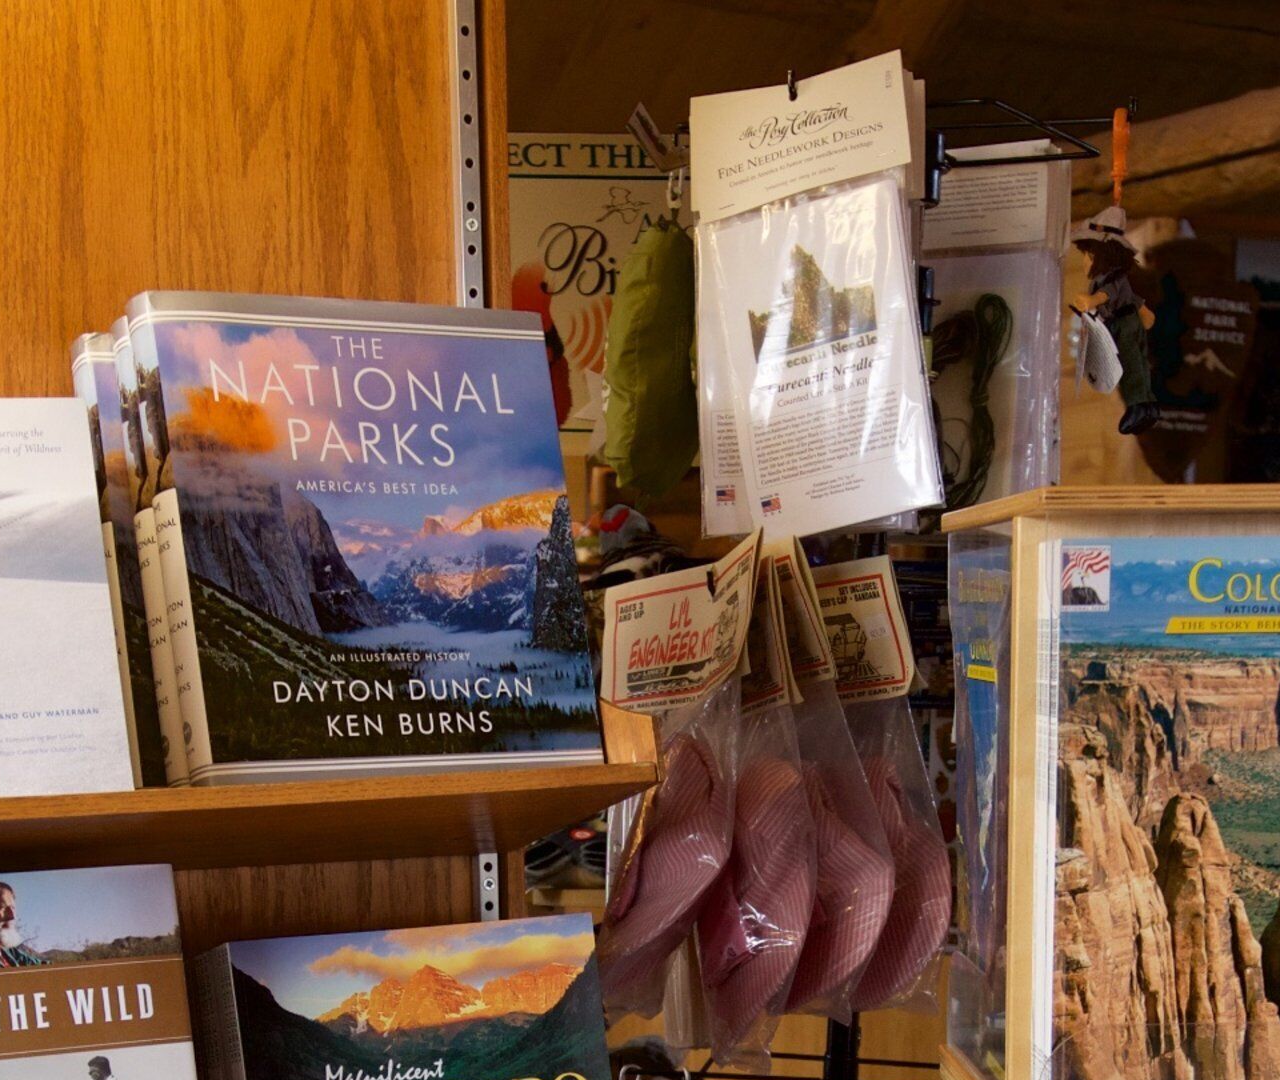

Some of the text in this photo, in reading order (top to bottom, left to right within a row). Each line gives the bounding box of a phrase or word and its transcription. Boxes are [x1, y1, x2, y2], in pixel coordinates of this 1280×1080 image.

[580, 144, 655, 168] THE
[718, 164, 744, 179] FINE
[747, 136, 829, 170] NEEDLEWORK
[832, 123, 884, 141] DESIGNS
[1191, 296, 1251, 314] NATIONAL
[1204, 313, 1237, 328] PARK
[1194, 328, 1245, 345] SERVICE
[331, 336, 384, 360] THE
[209, 358, 514, 415] NATIONAL
[287, 418, 455, 467] PARKS
[296, 480, 458, 496] AMERICA'S BEST IDEA
[839, 586, 849, 595] SET
[855, 591, 880, 602] BANDANA
[634, 611, 644, 619] UP
[1181, 621, 1206, 630] THE
[1211, 621, 1249, 630] STORY
[330, 652, 470, 662] AN ILLUSTRATED HISTORY
[628, 631, 699, 670] ENGINEER
[273, 677, 533, 703] DAYTON DUNCAN
[327, 711, 493, 737] KEN BURNS
[66, 983, 154, 1025] WILD
